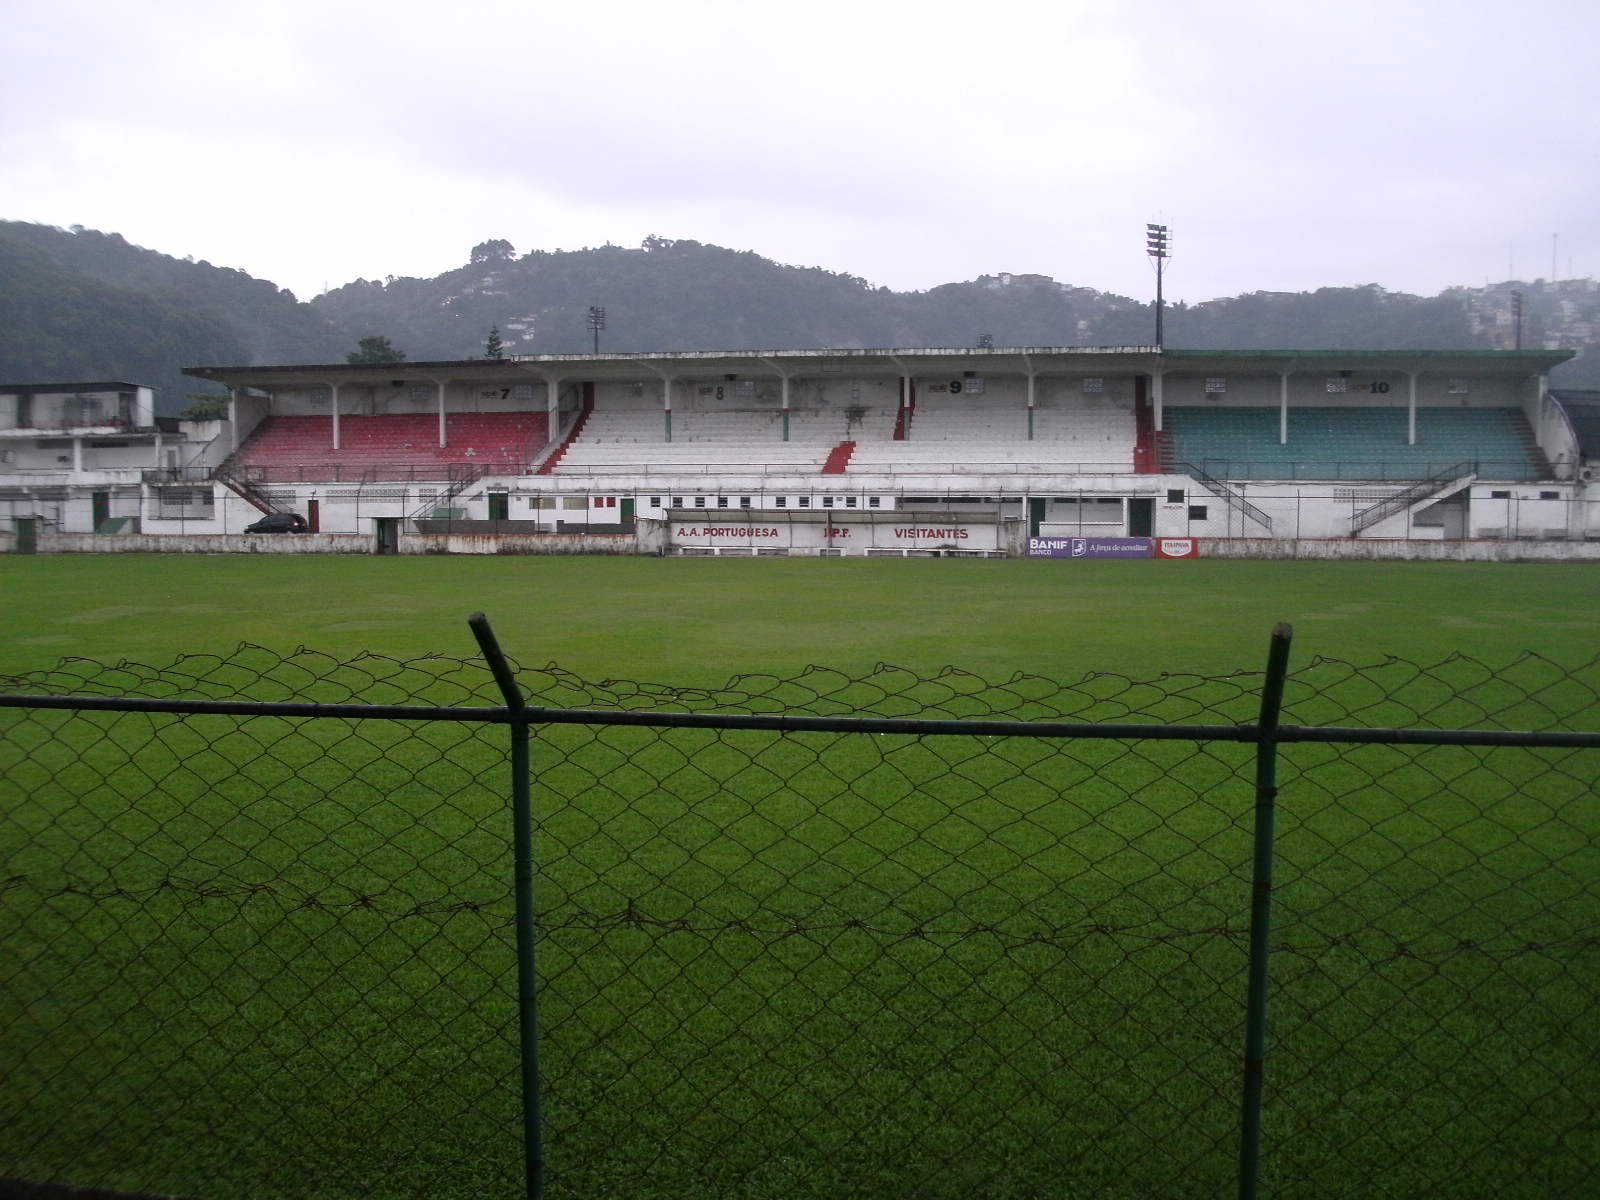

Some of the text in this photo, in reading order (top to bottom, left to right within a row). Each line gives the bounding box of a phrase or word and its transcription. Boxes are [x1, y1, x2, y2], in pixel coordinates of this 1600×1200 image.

[950, 380, 962, 394] 9
[1369, 382, 1390, 394] 10
[500, 388, 511, 400] 7
[716, 386, 724, 401] 8
[703, 527, 779, 537] PORTUGUESA
[894, 528, 969, 539] VISITANTES
[1029, 538, 1068, 550] BANIF
